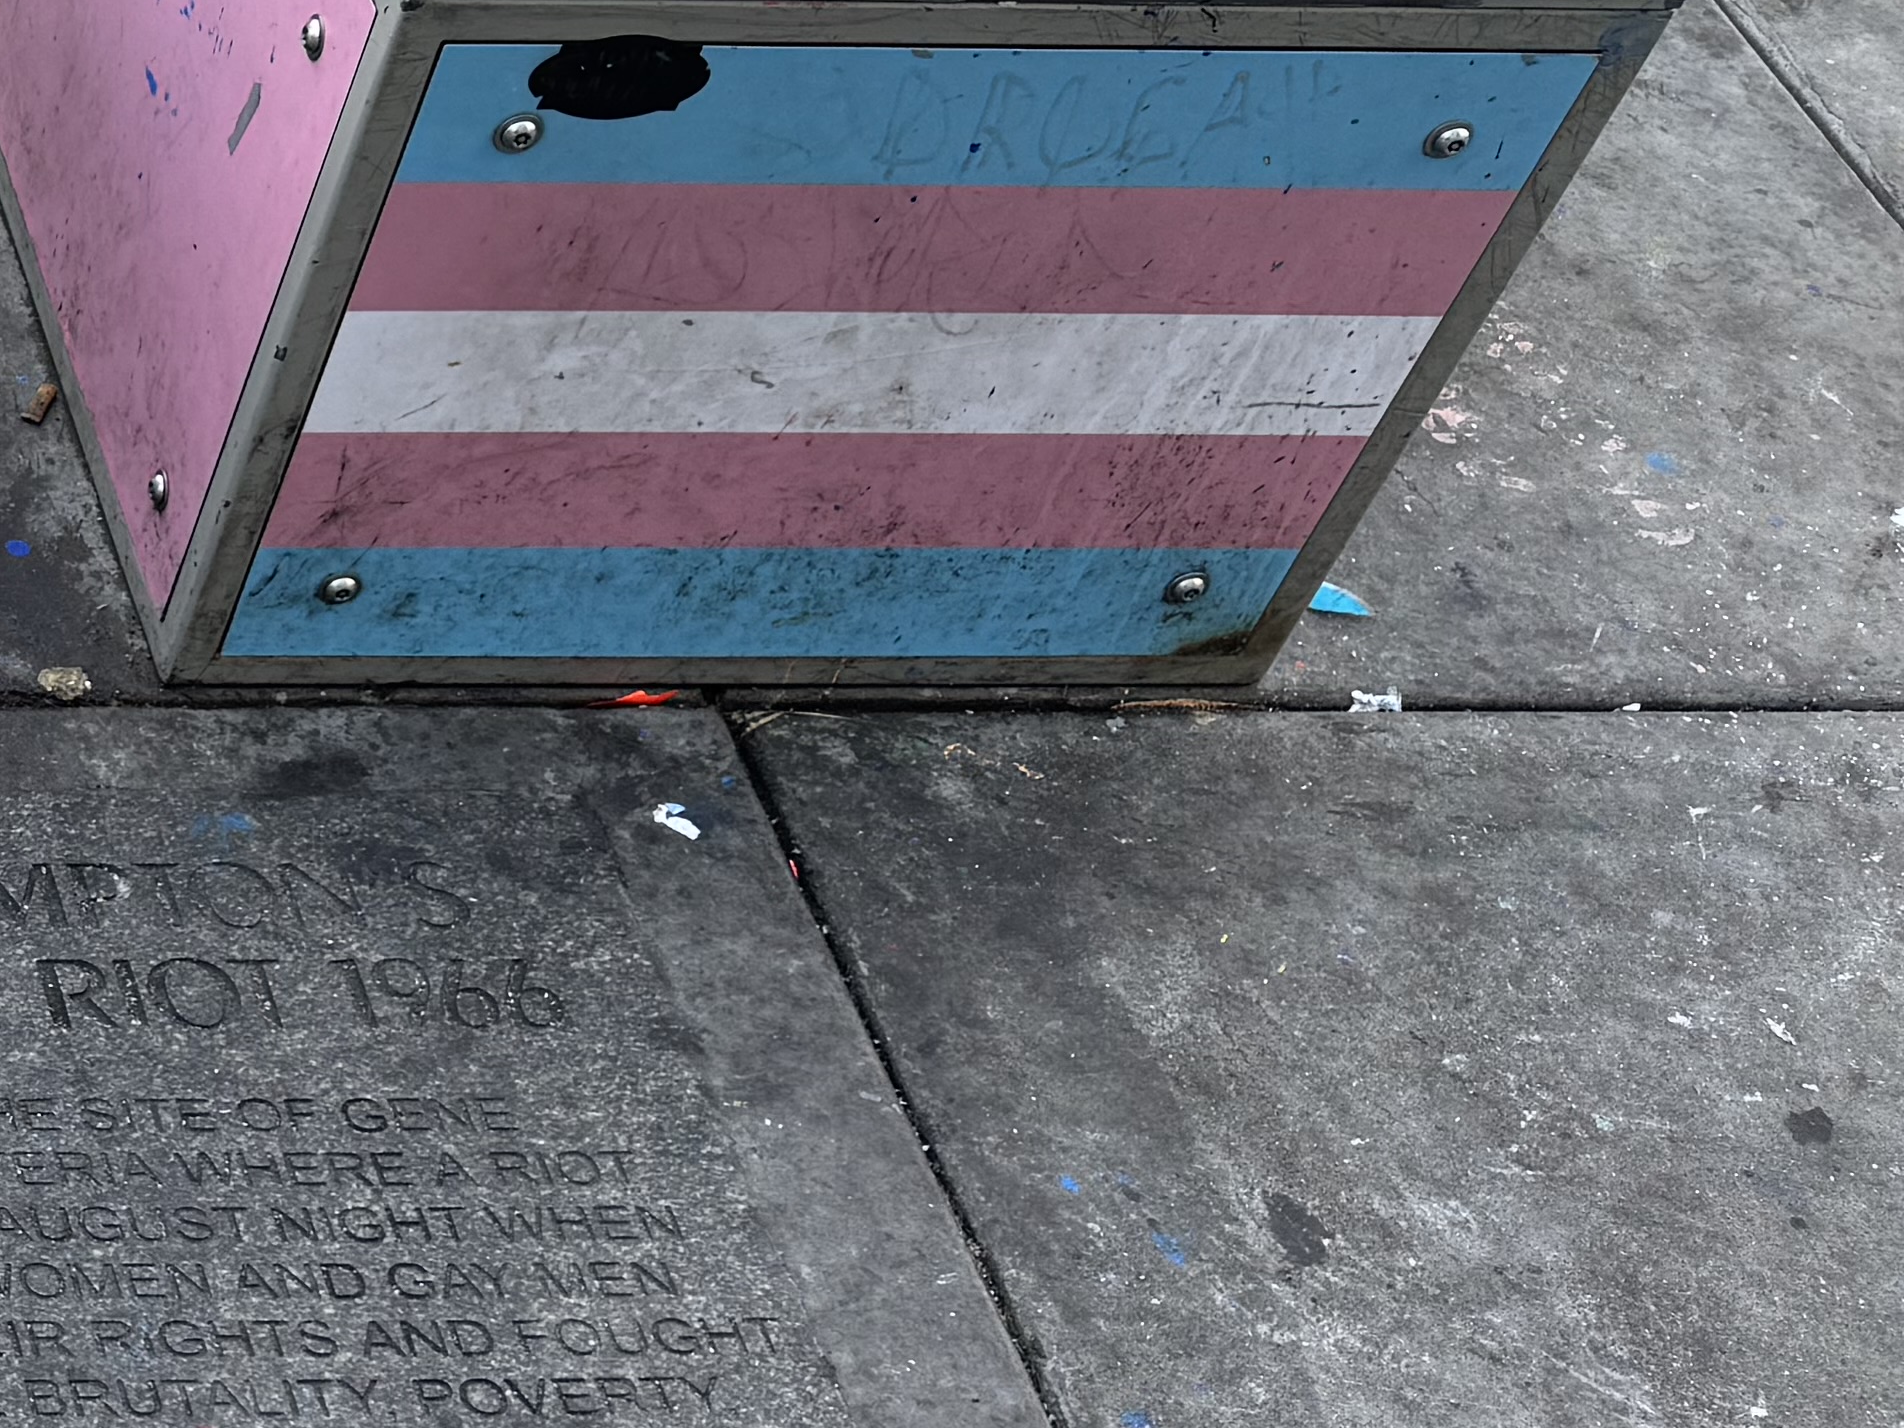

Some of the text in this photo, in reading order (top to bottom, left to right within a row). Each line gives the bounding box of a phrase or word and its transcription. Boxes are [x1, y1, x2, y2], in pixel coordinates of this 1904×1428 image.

[36, 958, 284, 1030] RIOT
[331, 958, 567, 1030] 1966
[81, 1098, 217, 1133] SITE
[236, 1097, 313, 1131] OF
[341, 1097, 518, 1133] GENE
[173, 1151, 413, 1186] WHERE
[436, 1151, 474, 1186] A
[490, 1150, 633, 1186] RIOT
[273, 1206, 467, 1241] NIGHT
[492, 1205, 686, 1241] WHEN
[238, 1263, 366, 1300] AND
[391, 1263, 514, 1300] GAY
[533, 1263, 678, 1299] MEN
[93, 1320, 337, 1357] RIGHTS
[362, 1320, 491, 1357] AND
[512, 1318, 784, 1355] FOUGHT
